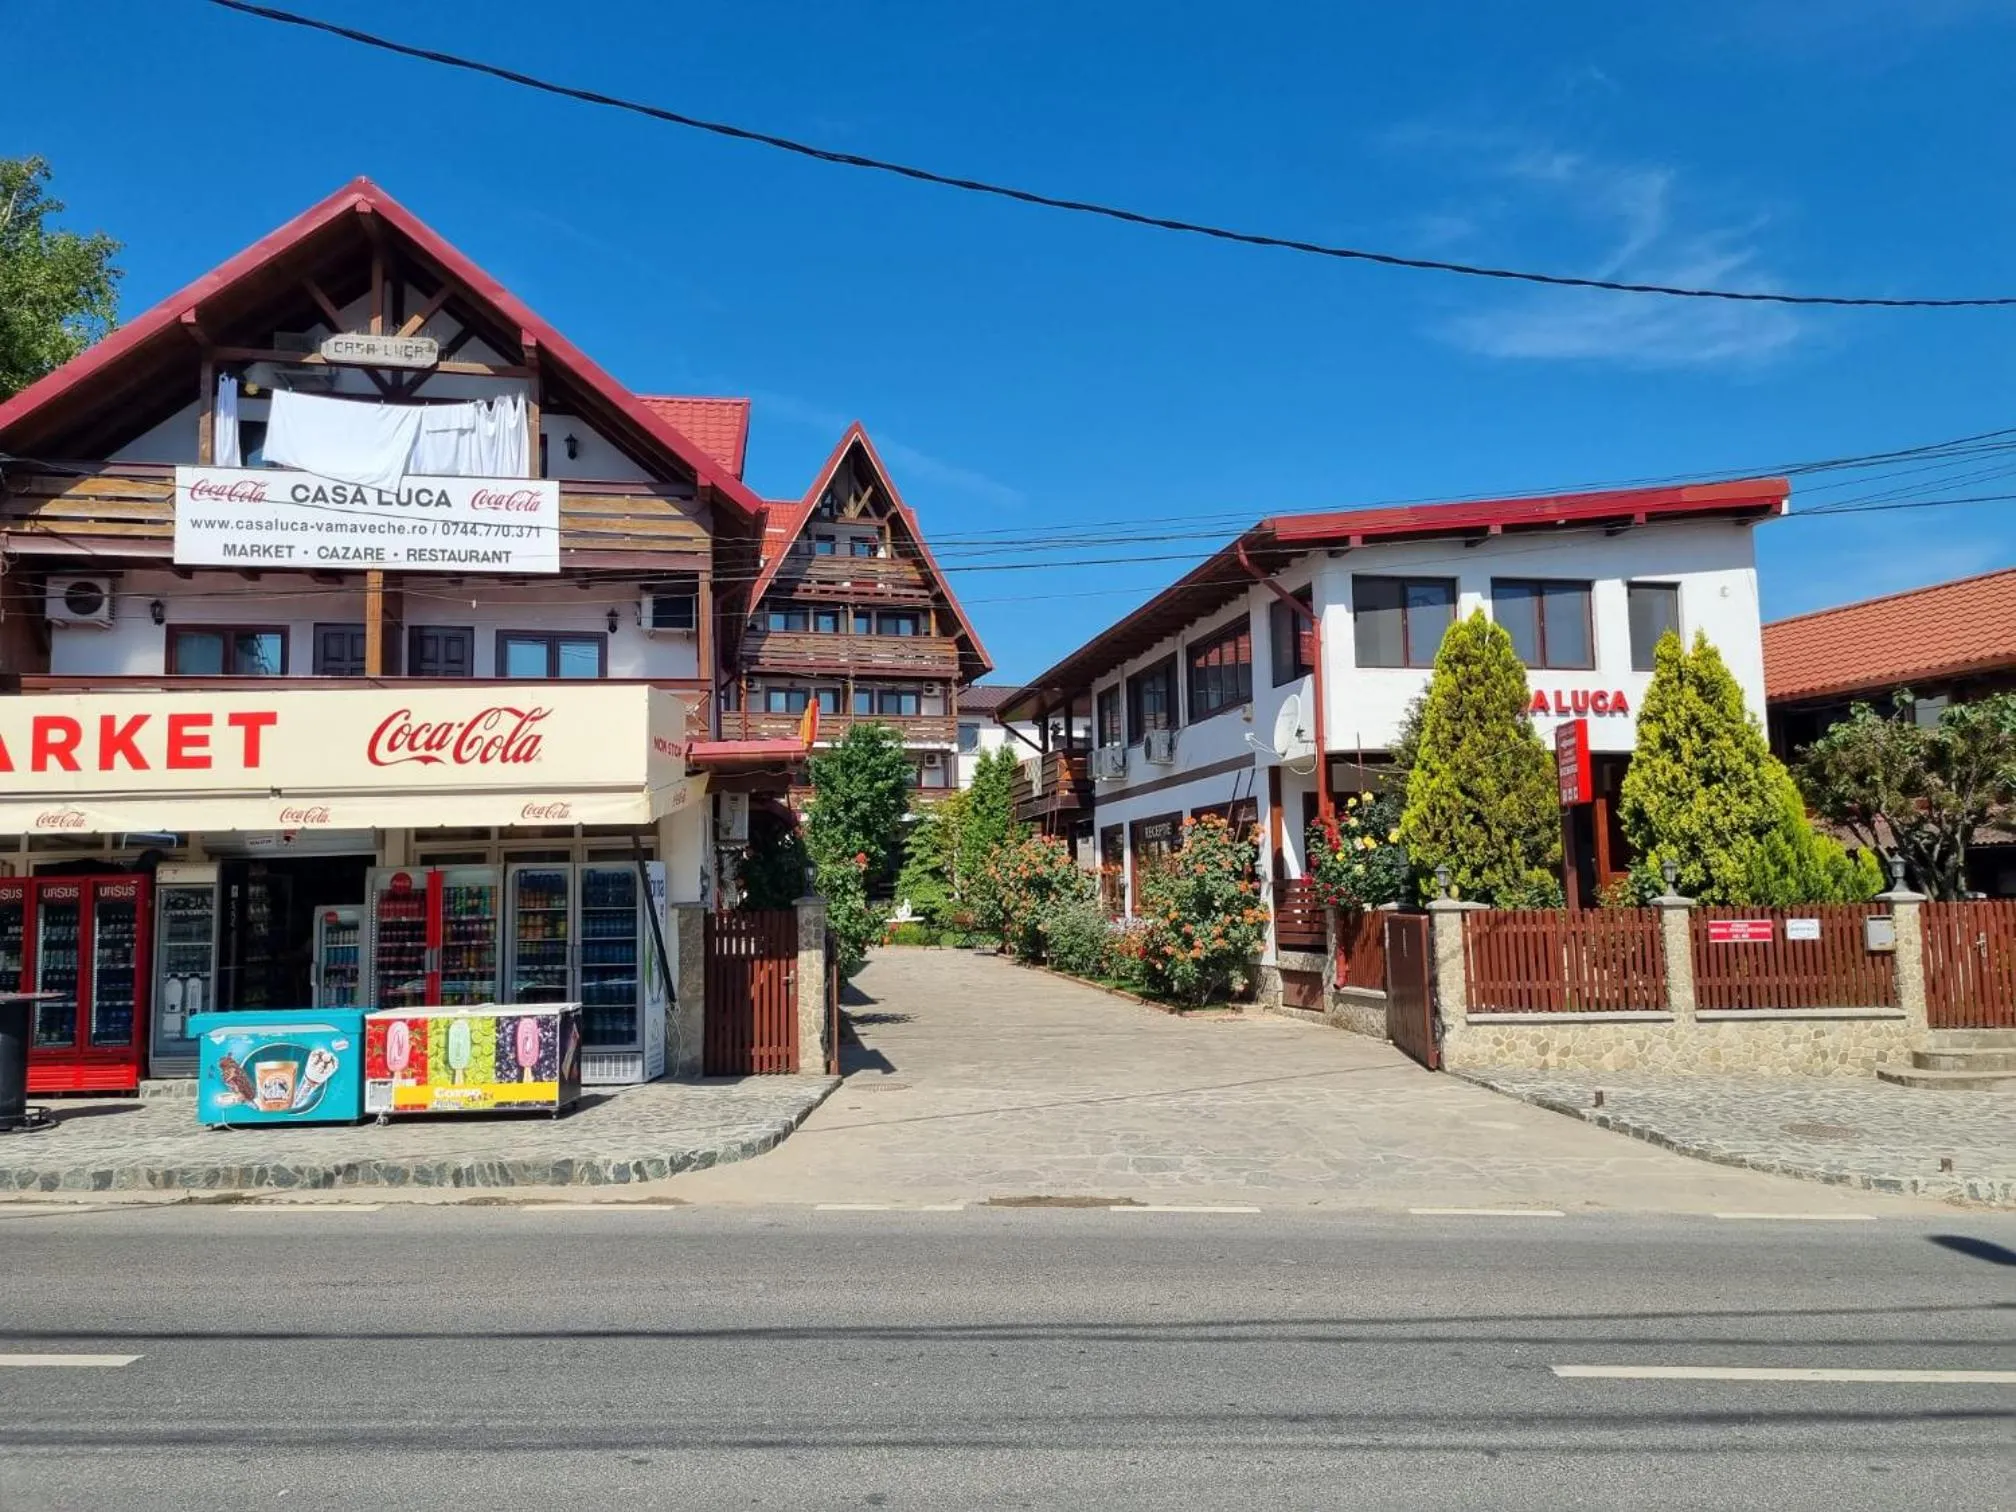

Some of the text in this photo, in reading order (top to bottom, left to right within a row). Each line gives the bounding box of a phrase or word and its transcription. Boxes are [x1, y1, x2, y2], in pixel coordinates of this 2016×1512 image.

[334, 342, 424, 359] CASA LUCA
[190, 478, 270, 503] Coca-Cola
[290, 483, 452, 509] CASA LUCA
[470, 488, 544, 513] Coca-Cola
[190, 517, 428, 535] www.casaluca-vamaveche.ro
[441, 522, 541, 538] 0744.770.371
[222, 543, 512, 564] MARKET CAZARE RESTAURANT
[1554, 689, 1630, 716] LUCA
[0, 712, 277, 772] RKET
[367, 707, 554, 767] Coca-Cola
[0, 888, 23, 900] SUS
